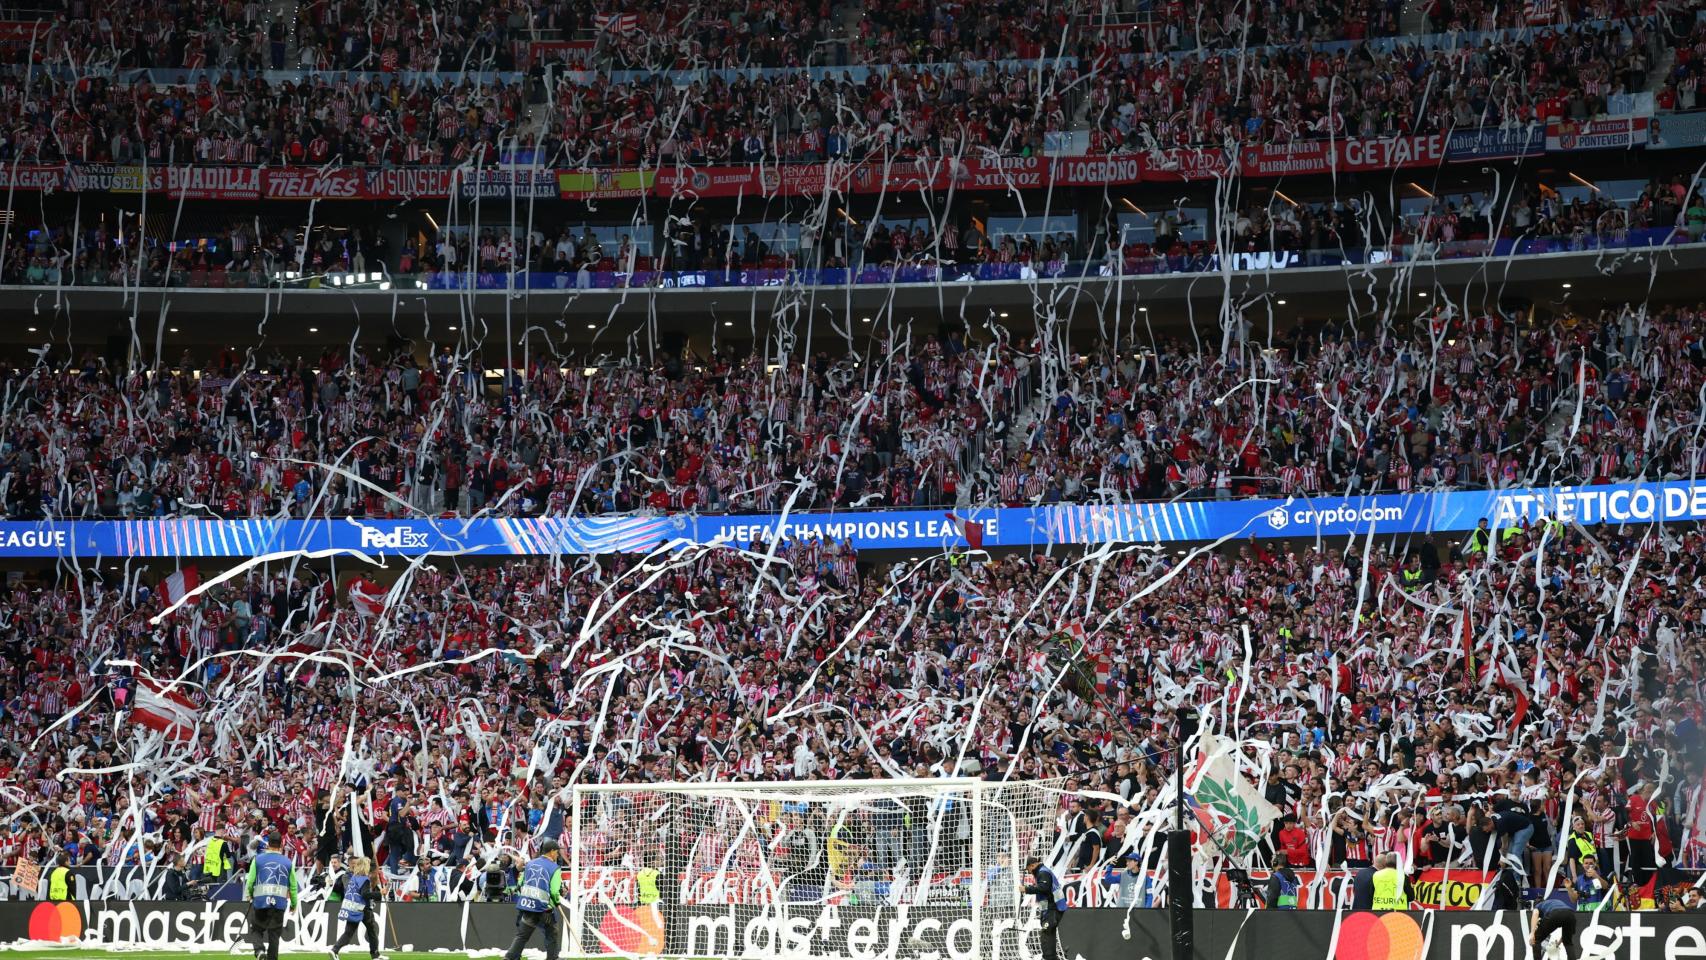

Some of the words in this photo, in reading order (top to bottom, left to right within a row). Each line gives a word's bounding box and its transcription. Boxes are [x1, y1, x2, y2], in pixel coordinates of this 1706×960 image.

[1345, 134, 1441, 165] GETAFE
[1578, 134, 1635, 147] PONTEVEDR
[1068, 157, 1137, 182] LOGROÑO
[77, 175, 163, 191] BRUSELAS
[267, 177, 360, 197] TIELMES
[1496, 485, 1656, 524] ATLÉTICO
[1294, 506, 1402, 526] crypto.com
[360, 527, 428, 549] FedEx
[720, 524, 774, 543] UEFA
[781, 521, 909, 542] CHAMPIONS
[520, 898, 537, 909] 023
